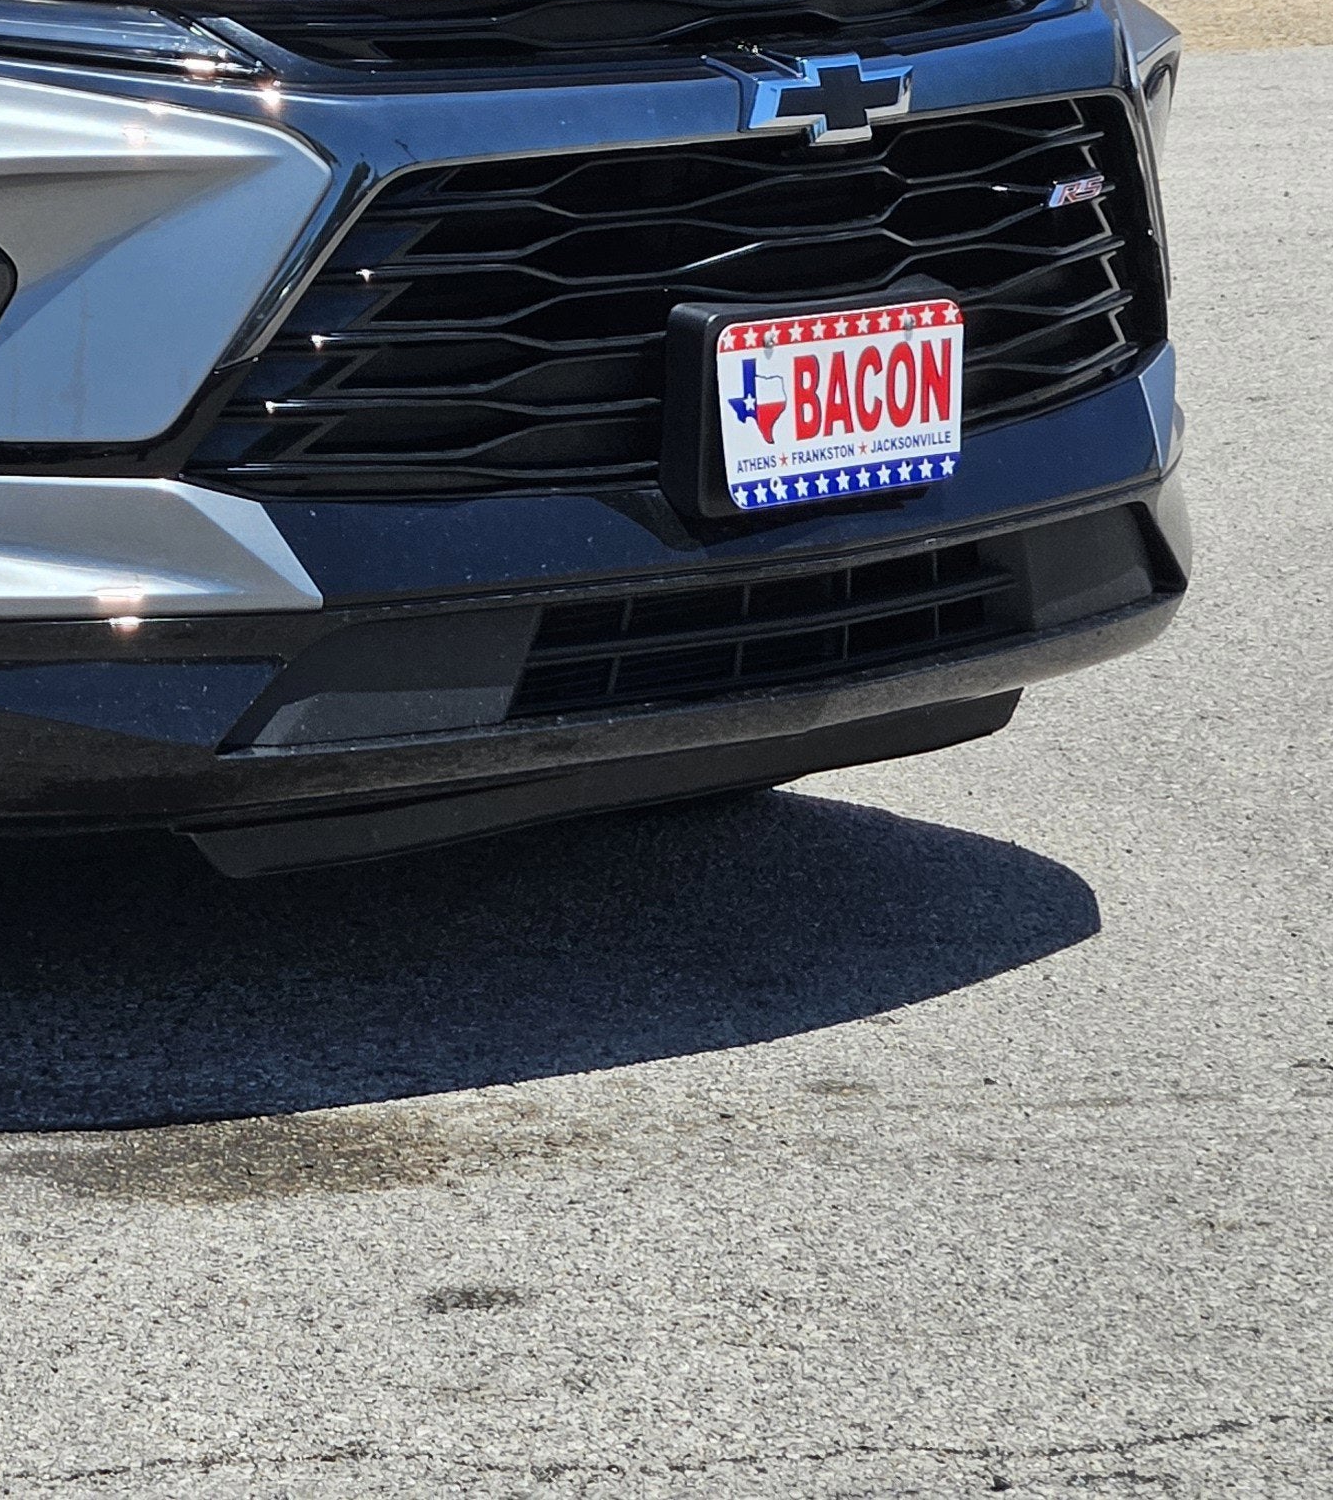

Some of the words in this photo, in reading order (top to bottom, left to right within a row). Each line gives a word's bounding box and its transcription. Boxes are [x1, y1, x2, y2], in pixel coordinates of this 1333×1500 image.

[1055, 176, 1104, 206] RS
[794, 338, 951, 440] BACON
[737, 455, 777, 473] ATHENS
[792, 443, 855, 465] FRANKSTON
[870, 431, 951, 454] JACKSONVILLE
